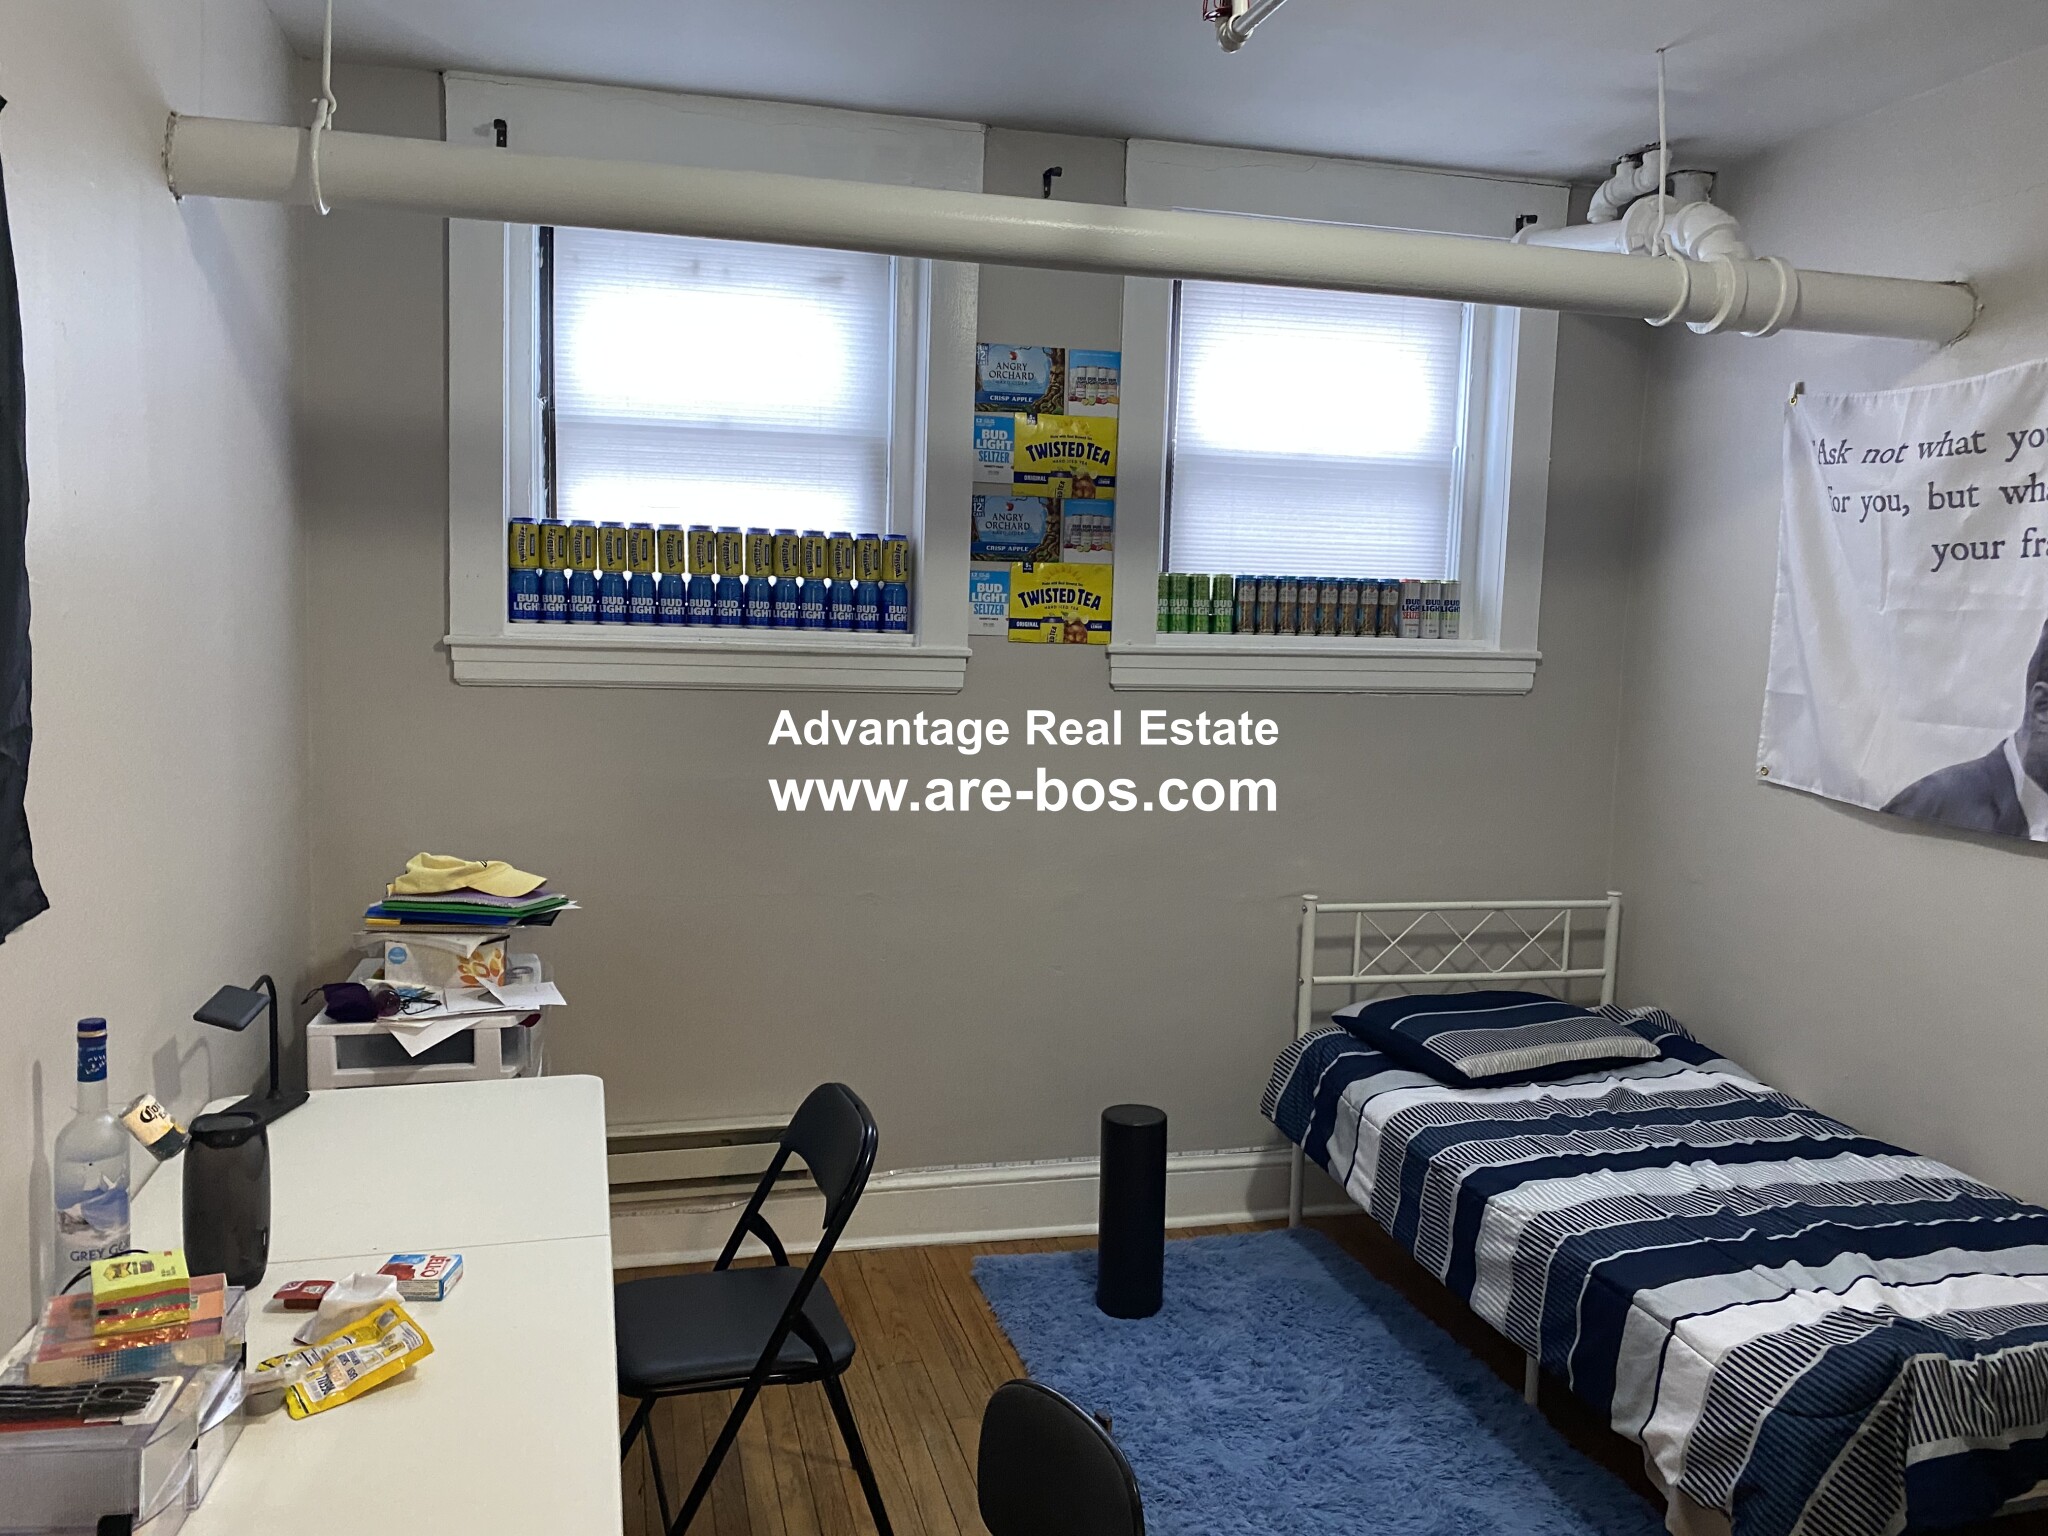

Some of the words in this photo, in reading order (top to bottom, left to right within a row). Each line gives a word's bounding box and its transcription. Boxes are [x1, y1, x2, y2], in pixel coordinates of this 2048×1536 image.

[996, 362, 1027, 371] ANGRY
[988, 370, 1034, 380] ORCHARD
[981, 429, 1008, 440] BUD
[976, 439, 1013, 450] LIGHT
[1861, 442, 1909, 464] not
[1918, 430, 1987, 460] what
[2005, 428, 2048, 462] yo
[979, 451, 1009, 463] SELTZER
[1025, 441, 1085, 462] TWISTED
[1087, 442, 1111, 466] TEA
[1859, 493, 1910, 523] you,
[1928, 481, 1979, 510] but
[1999, 472, 2048, 504] wh
[973, 503, 982, 512] 12
[992, 513, 1024, 521] ANGRY
[985, 521, 1030, 530] ORCHARD
[547, 528, 556, 539] TEA
[575, 529, 583, 540] TEA
[666, 533, 675, 544] TEA
[782, 538, 790, 549] TEA
[806, 540, 814, 550] TEA
[547, 539, 556, 564] TWISTED
[575, 540, 583, 565] TWISTED
[606, 542, 614, 566] TWISTED
[1931, 540, 2005, 572] your
[2020, 527, 2048, 558] fr
[666, 545, 675, 568] TWISTED
[782, 549, 791, 573] TWISTED
[806, 550, 814, 574] TWISTED
[835, 551, 843, 575] TWISTED
[976, 583, 1003, 593] BUD
[517, 594, 539, 602] BUD
[542, 595, 565, 603] BUD
[571, 595, 594, 604] BUD
[601, 596, 624, 605] BUD
[631, 597, 653, 606] BUD
[661, 598, 682, 606] BUD
[971, 593, 1007, 602] LIGHT
[1018, 588, 1075, 608] TWISTED
[1078, 589, 1101, 610] TEA
[513, 602, 539, 611] LIGH
[690, 599, 711, 607] BUD
[717, 600, 738, 608] BUD
[749, 601, 769, 609] BUD
[775, 601, 797, 610] BUD
[802, 603, 823, 611] BUD
[1170, 599, 1188, 607] BUD
[569, 604, 596, 612] LIGHT
[600, 605, 627, 613] LIGHT
[629, 606, 656, 614] LIGHT
[659, 606, 685, 615] LIGHT
[688, 607, 714, 616] LIGHT
[832, 604, 852, 612] BUD
[857, 605, 877, 613] BUD
[889, 605, 907, 614] BUD
[974, 604, 1004, 615] SELTZER
[1190, 607, 1209, 615] LIGH
[773, 609, 798, 618] LIGHT
[855, 613, 880, 621] LIGHT
[885, 614, 907, 622] LIGH
[70, 1248, 105, 1261] GREY
